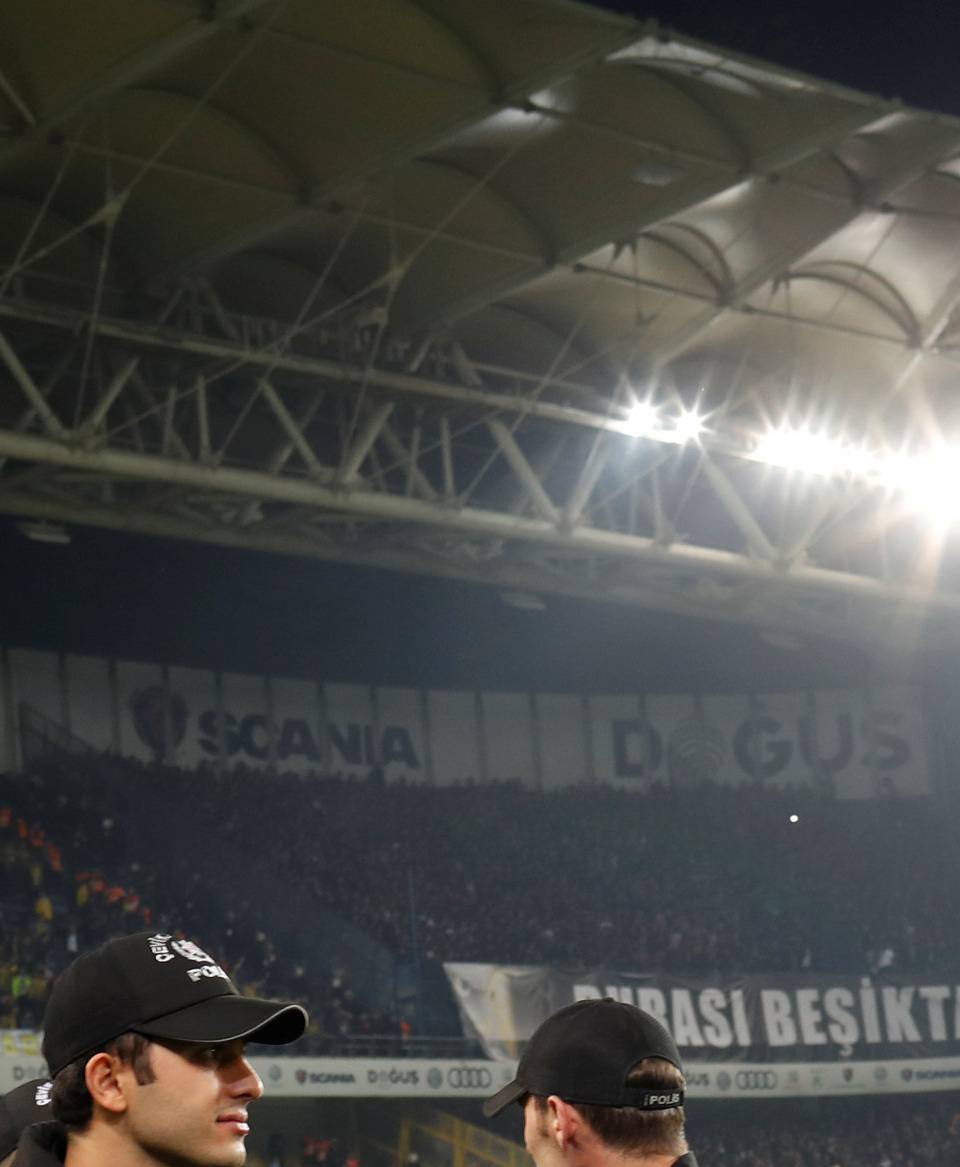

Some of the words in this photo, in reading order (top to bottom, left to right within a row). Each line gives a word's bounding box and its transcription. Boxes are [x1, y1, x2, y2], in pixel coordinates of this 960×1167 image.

[197, 711, 421, 768] SCANIA
[572, 984, 751, 1046] RASI
[760, 977, 960, 1056] BEŞİKT
